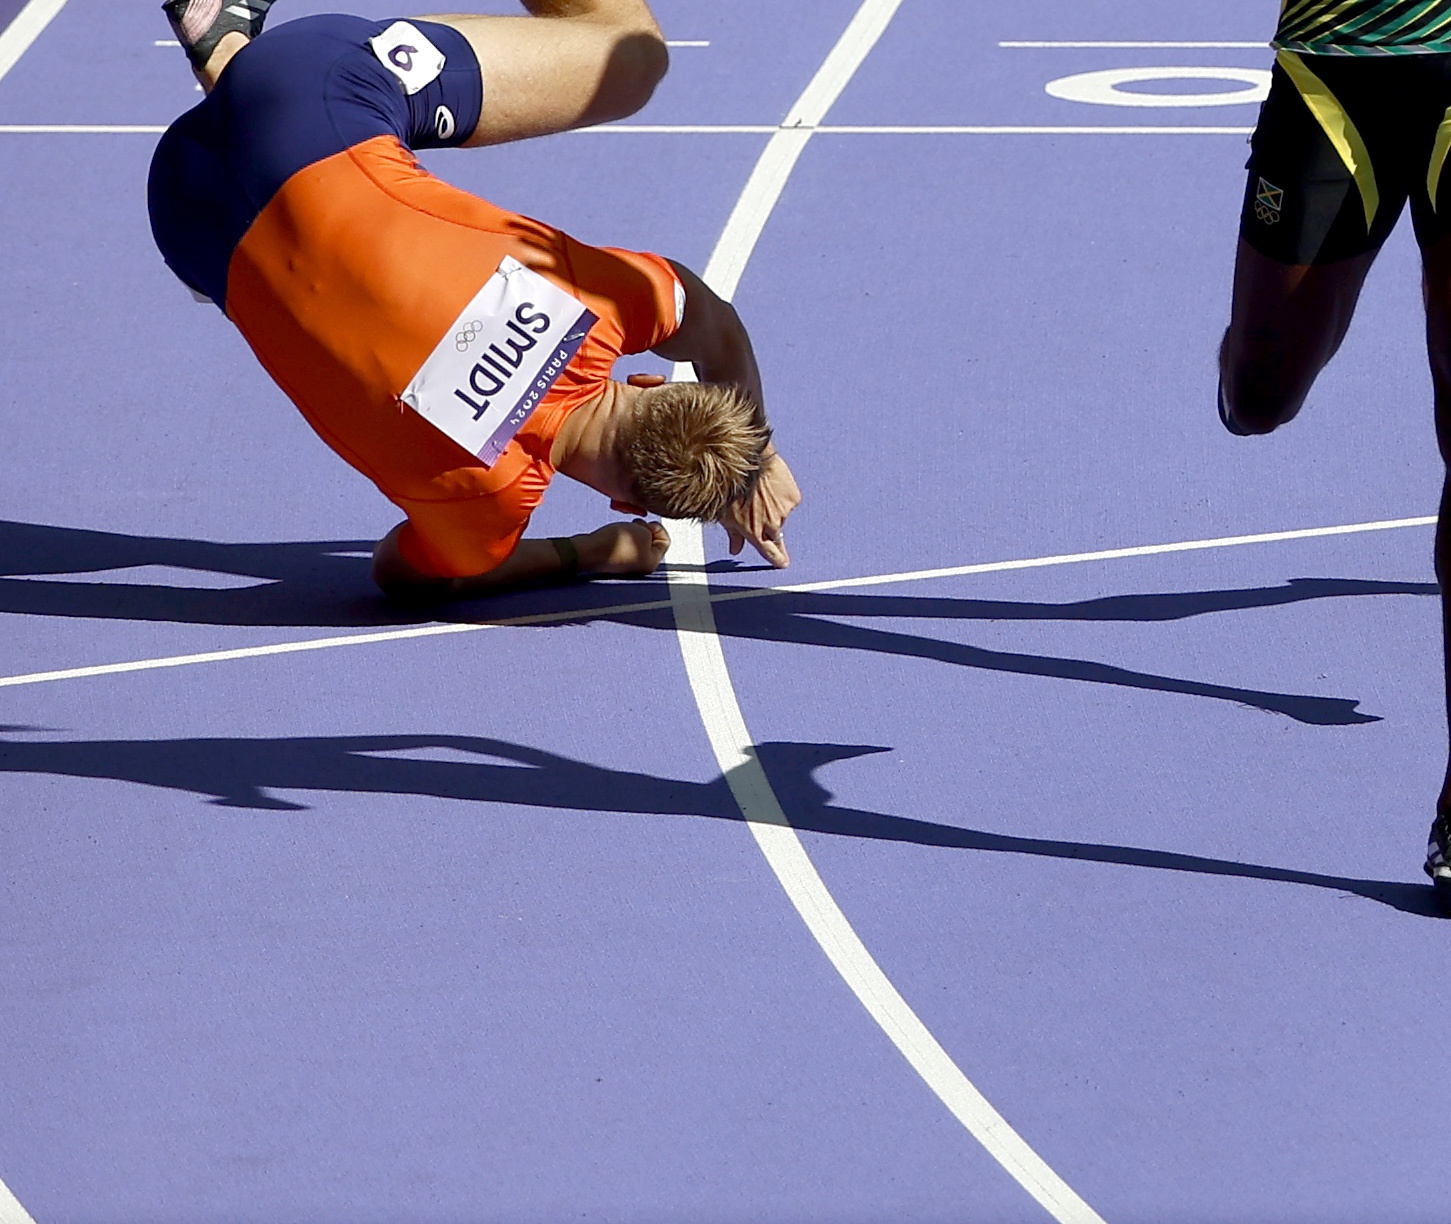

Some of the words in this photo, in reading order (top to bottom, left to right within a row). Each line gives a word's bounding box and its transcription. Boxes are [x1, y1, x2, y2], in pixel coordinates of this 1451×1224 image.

[453, 301, 551, 422] SMIDT
[536, 349, 568, 390] PARIS
[510, 390, 539, 425] 2024
